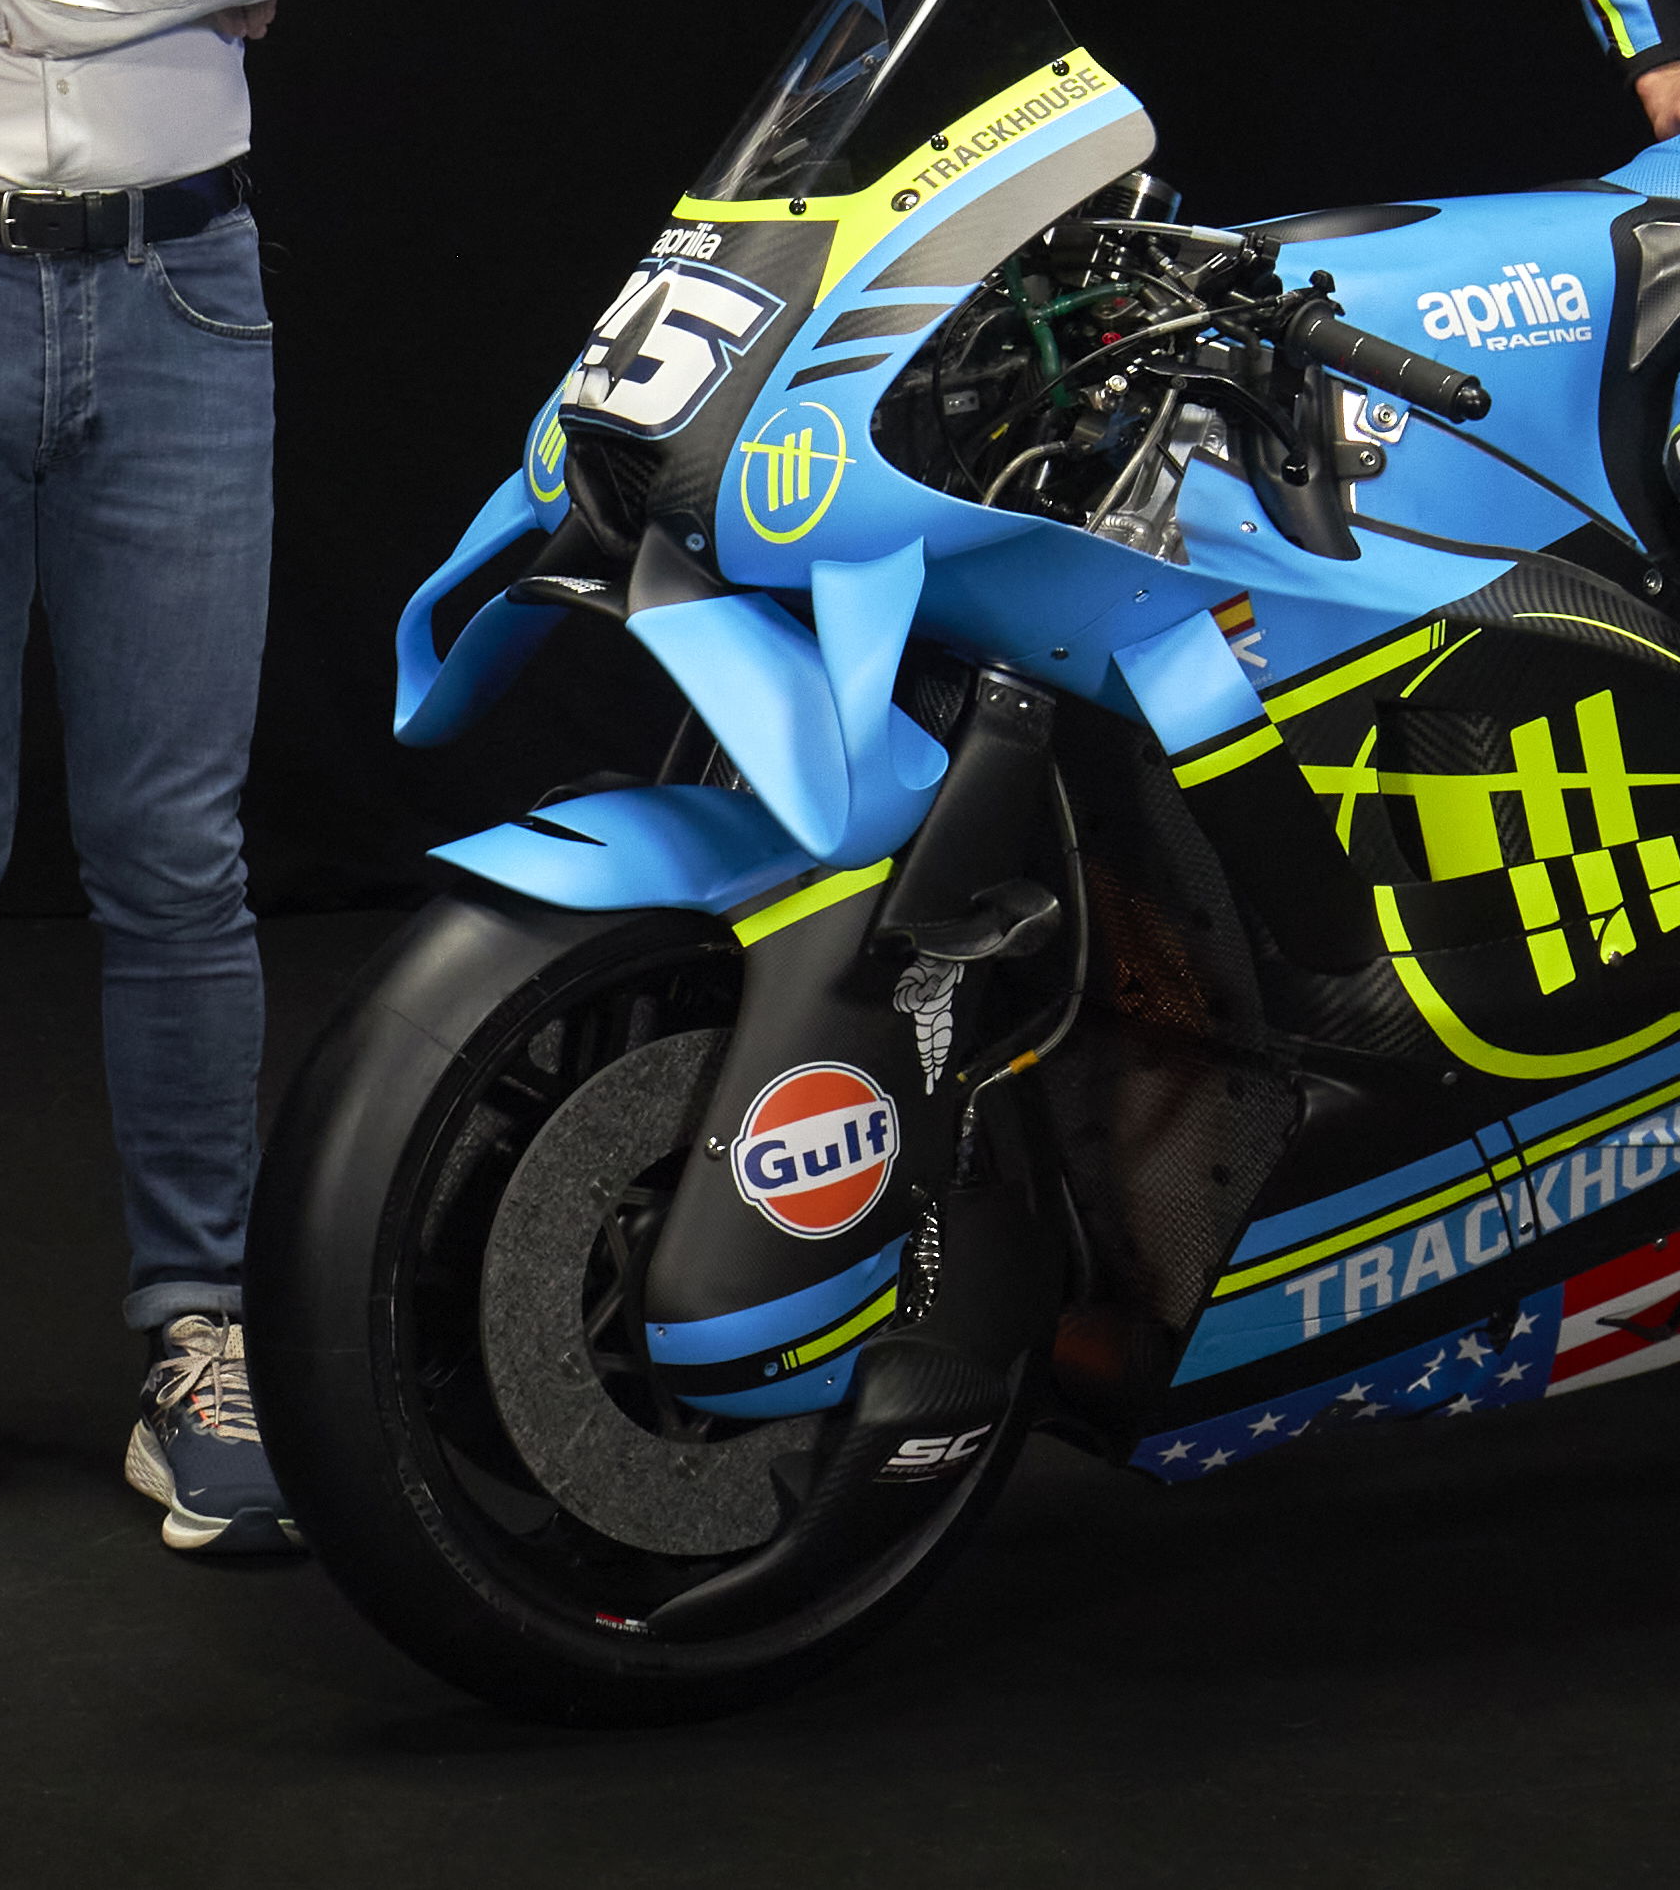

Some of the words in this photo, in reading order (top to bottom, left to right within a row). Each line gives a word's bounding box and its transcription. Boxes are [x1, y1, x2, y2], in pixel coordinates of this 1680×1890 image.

[912, 68, 1107, 192] TRACKHOUSE
[650, 222, 723, 261] aprilia
[1416, 262, 1590, 349] aprilia
[1486, 326, 1593, 352] RACING
[743, 1110, 891, 1191] Gulf
[886, 1422, 993, 1467] SC
